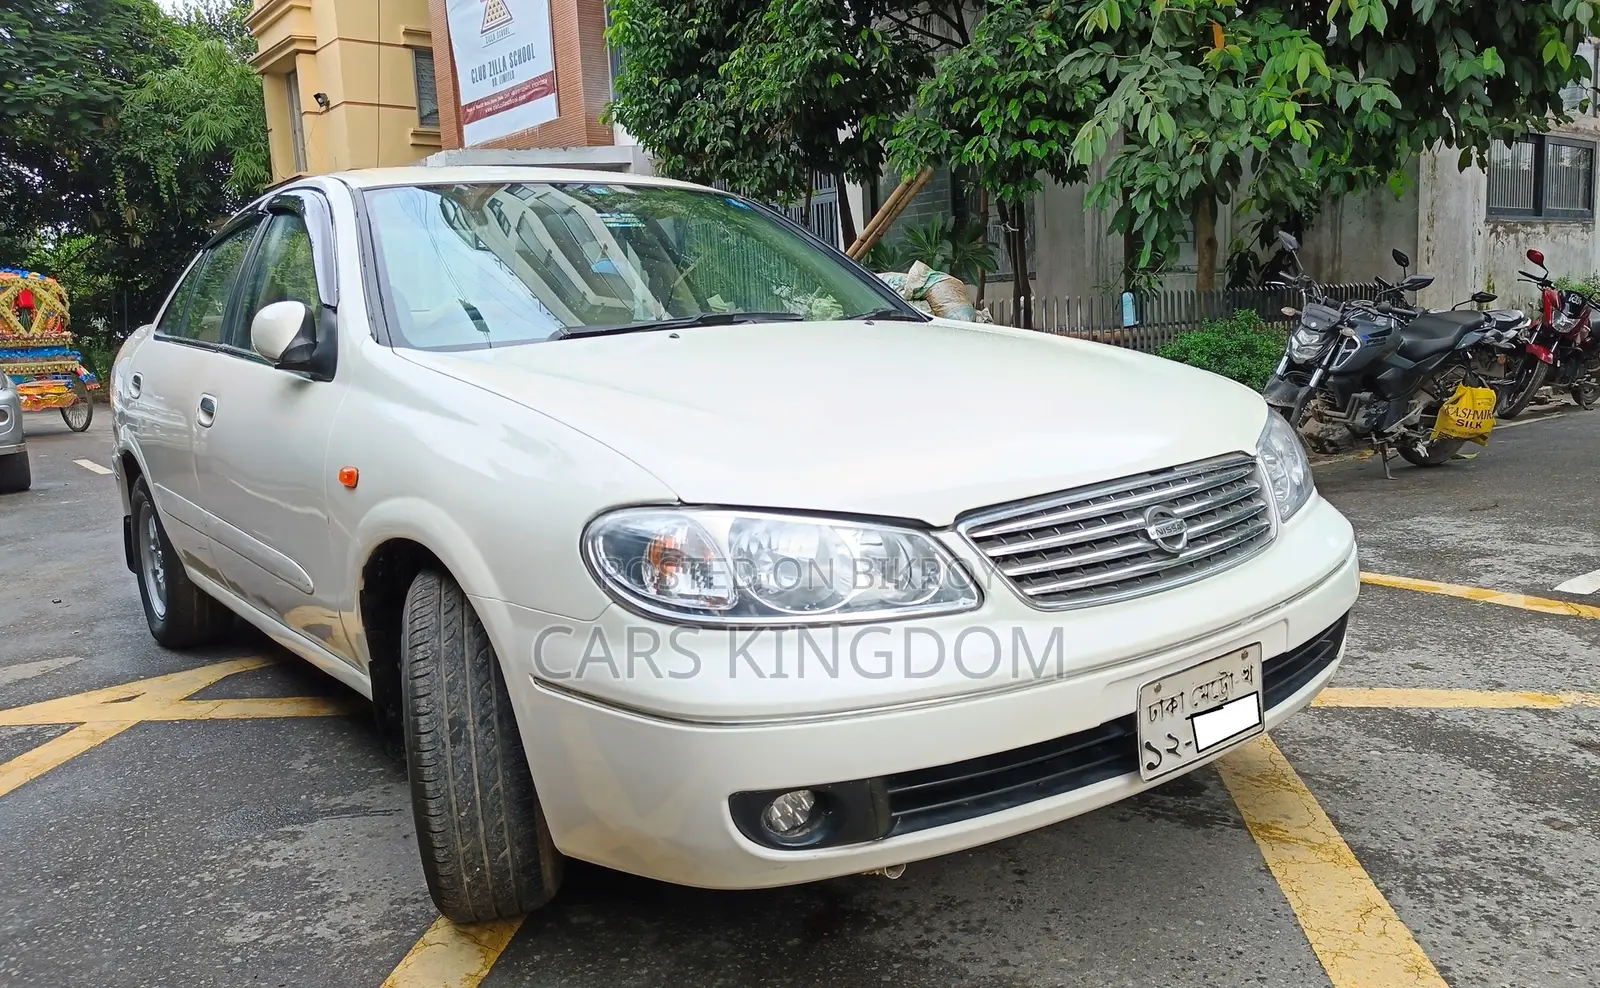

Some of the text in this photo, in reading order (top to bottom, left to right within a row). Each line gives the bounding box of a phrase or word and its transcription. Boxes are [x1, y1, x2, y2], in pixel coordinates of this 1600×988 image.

[485, 31, 496, 44] ZILLA
[470, 42, 536, 84] CLUB ZILLA SCHOOL
[1456, 419, 1482, 429] SILK
[1147, 691, 1184, 723] ঢাকা
